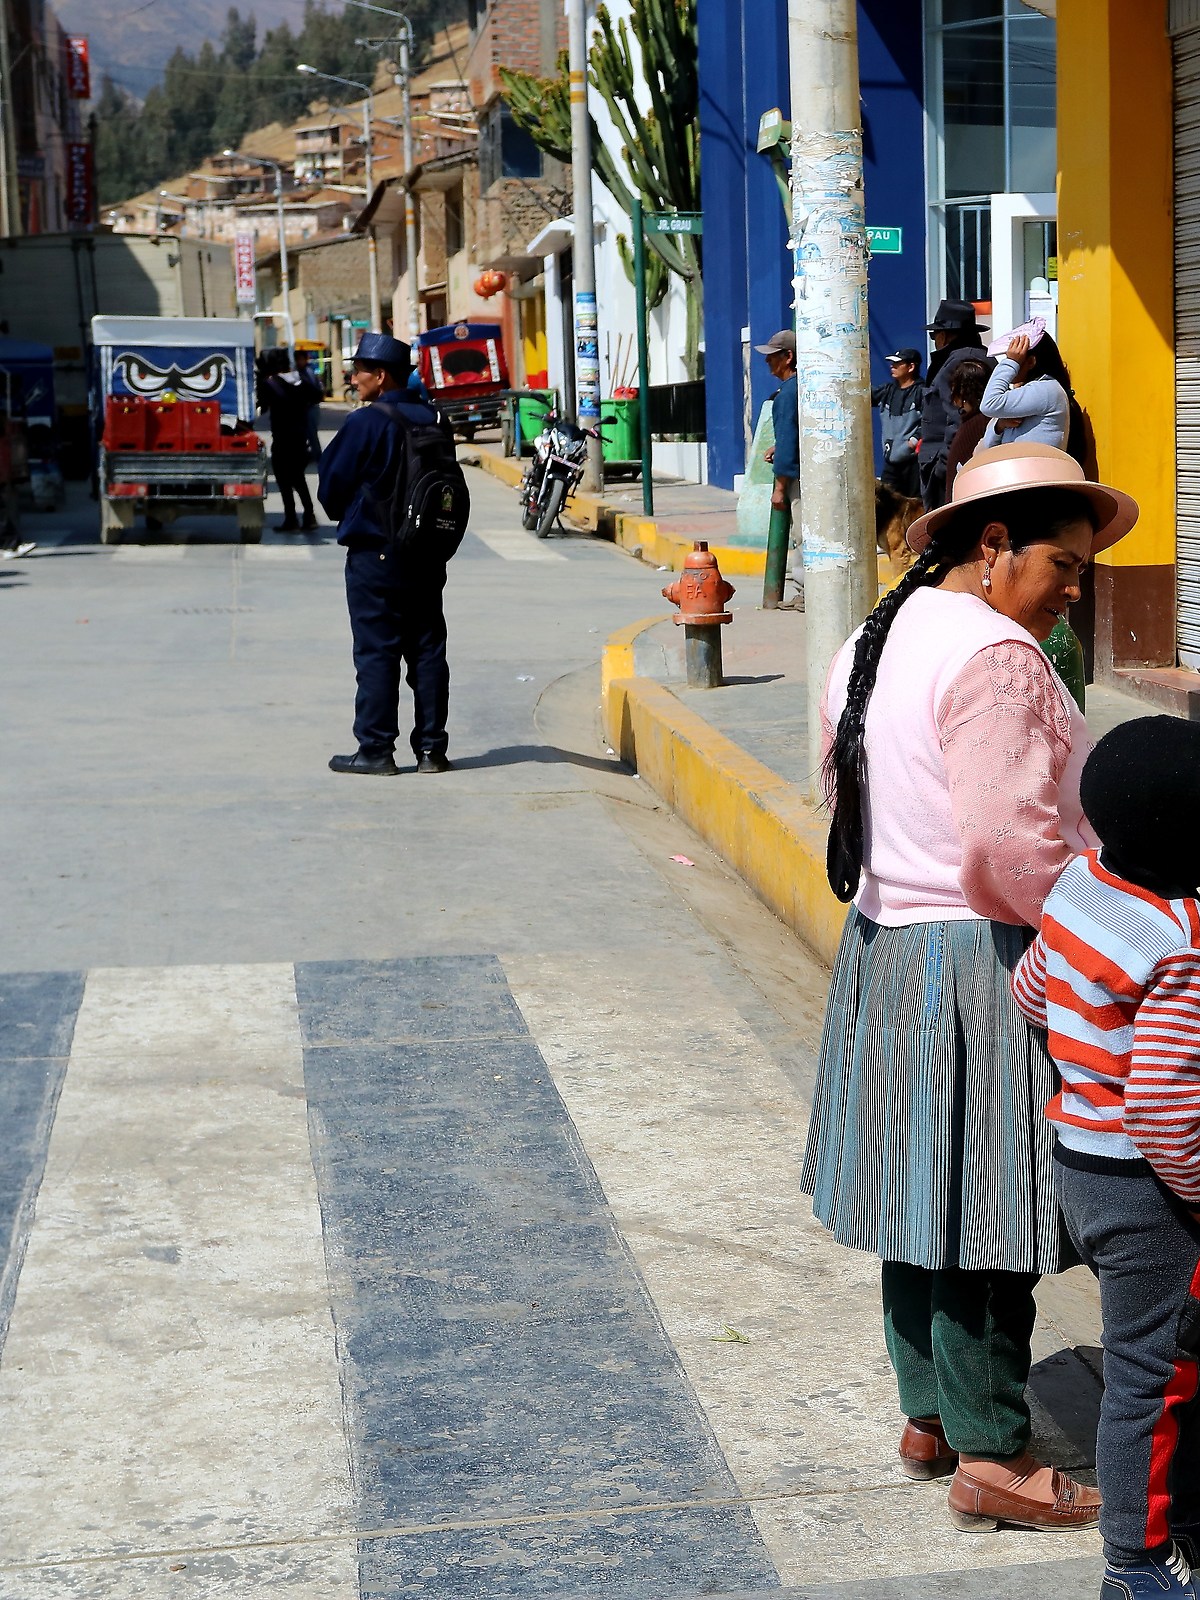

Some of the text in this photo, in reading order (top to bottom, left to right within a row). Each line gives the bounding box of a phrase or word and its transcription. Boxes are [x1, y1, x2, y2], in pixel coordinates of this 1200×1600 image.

[657, 219, 692, 231] JR. GRAU
[866, 230, 890, 240] RAU
